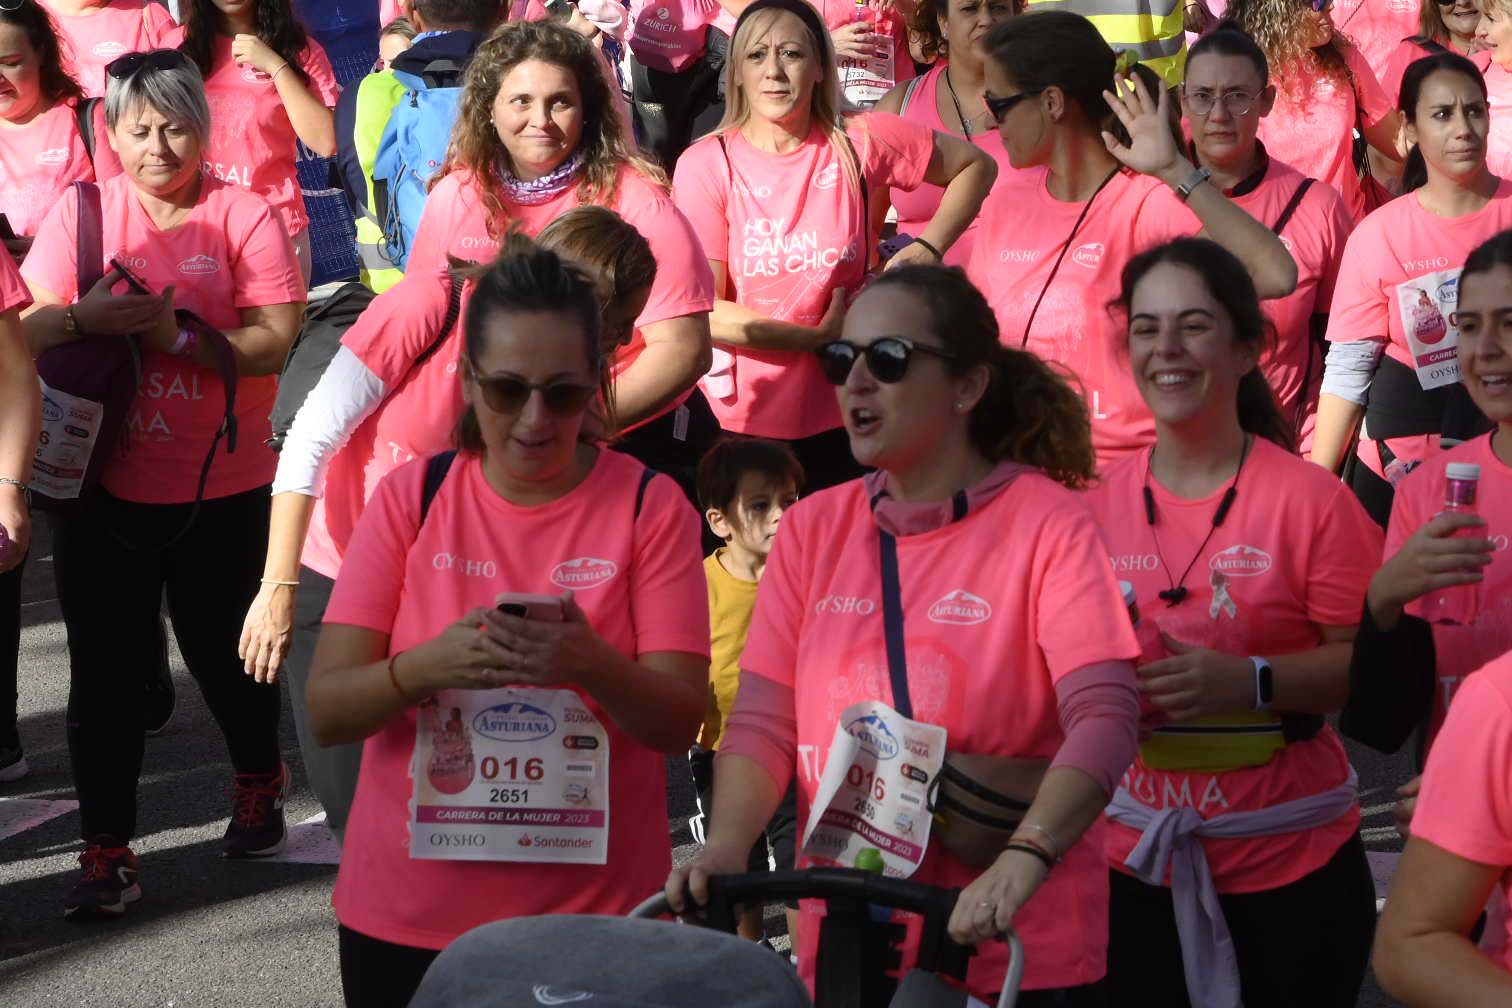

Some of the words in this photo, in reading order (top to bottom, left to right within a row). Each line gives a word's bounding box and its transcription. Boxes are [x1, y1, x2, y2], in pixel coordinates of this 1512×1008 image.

[744, 218, 787, 237] HOY
[744, 231, 818, 257] GANAN
[744, 255, 784, 277] LAS
[784, 241, 857, 274] CHICAS
[1212, 558, 1269, 570] ASTURIANA
[478, 716, 549, 733] ASTURIANA
[480, 757, 545, 783] 016
[847, 764, 886, 801] 016
[489, 788, 529, 804] 2651
[436, 810, 486, 821] CARRERA
[488, 811, 507, 821] DE
[508, 812, 521, 822] LA
[523, 813, 560, 823] MUJER
[430, 832, 486, 847] OYSHO
[533, 835, 593, 849] Santander
